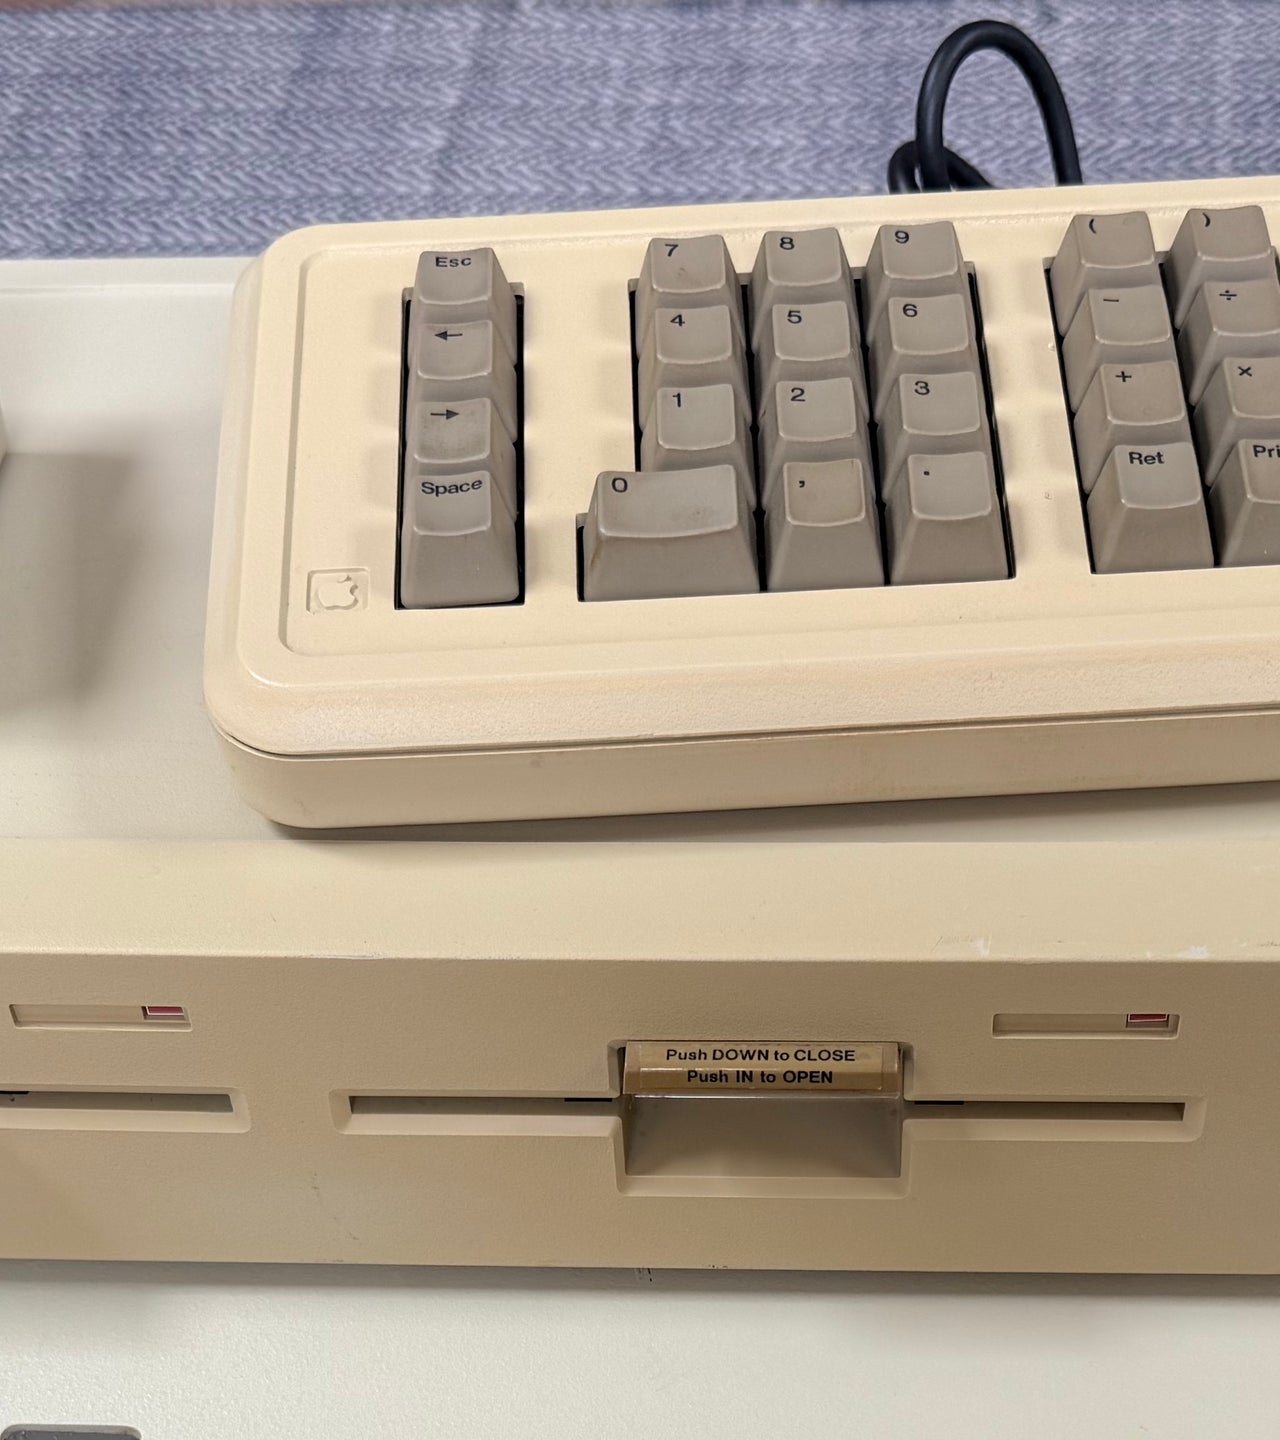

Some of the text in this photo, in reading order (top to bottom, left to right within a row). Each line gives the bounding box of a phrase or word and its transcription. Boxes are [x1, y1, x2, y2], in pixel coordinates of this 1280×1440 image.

[779, 236, 795, 251] 8
[894, 229, 910, 245] 9
[664, 243, 679, 258] 7
[435, 256, 472, 268] Esc
[787, 309, 803, 325] 5
[902, 303, 919, 319] 6
[670, 313, 685, 327] 4
[790, 386, 806, 403] 2
[914, 380, 930, 396] 3
[672, 392, 682, 408] 1
[1128, 451, 1165, 466] Ret
[421, 477, 483, 498] Space
[612, 477, 628, 494] 0
[666, 1048, 856, 1062] Push DOWN to CLOSE
[687, 1069, 833, 1084] Push IN to OPEN
